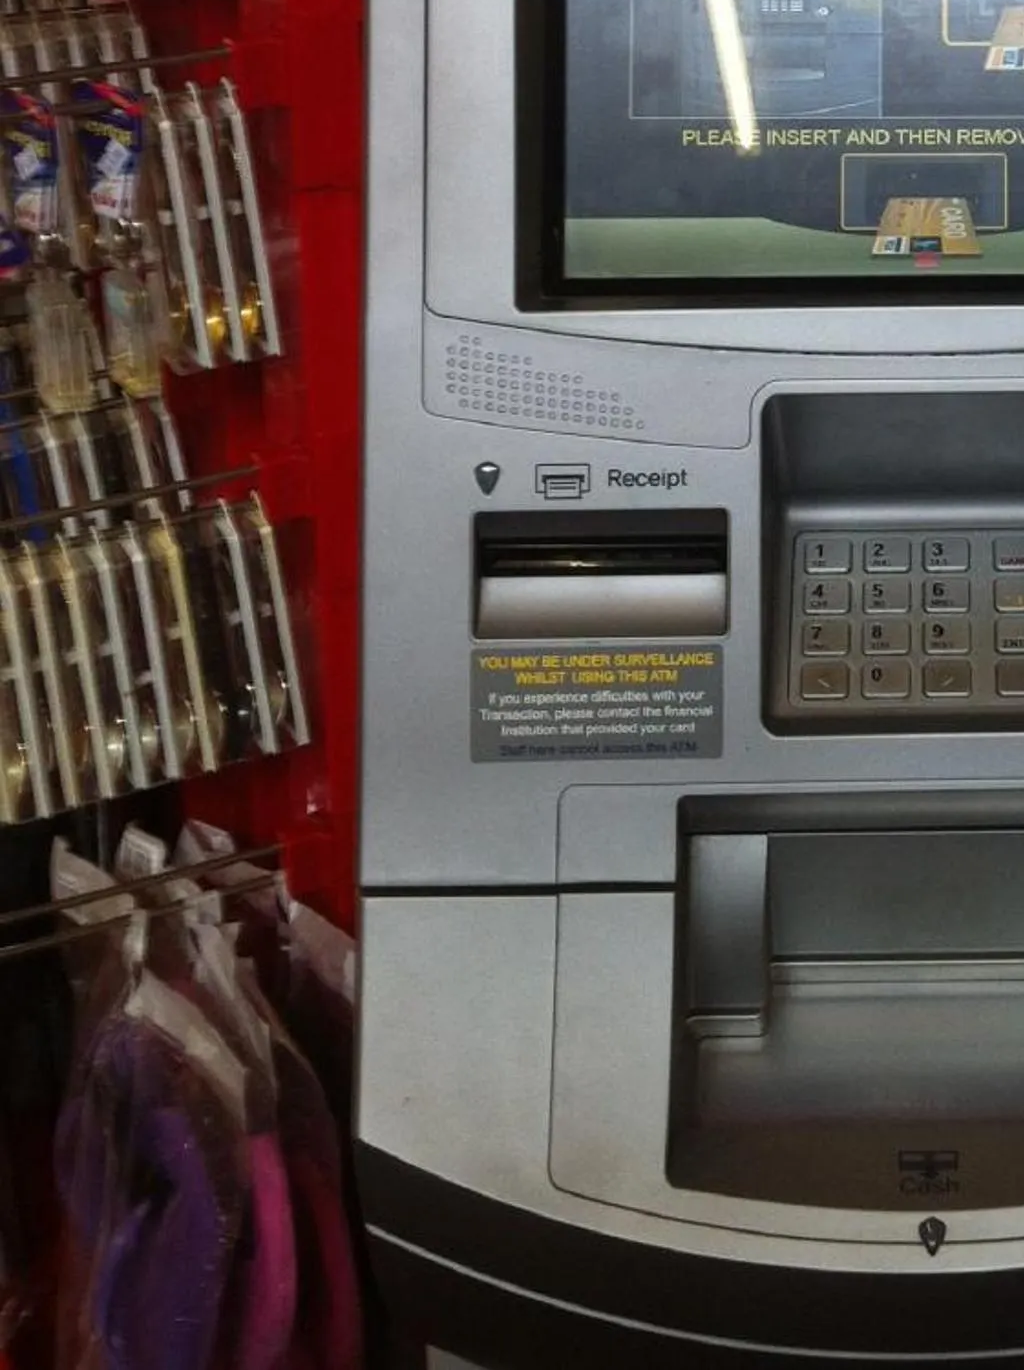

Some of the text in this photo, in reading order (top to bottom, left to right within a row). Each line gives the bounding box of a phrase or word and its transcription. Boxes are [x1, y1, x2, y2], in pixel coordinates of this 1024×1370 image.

[767, 129, 840, 145] INSERT
[846, 129, 890, 145] AND
[895, 128, 951, 145] THEN
[607, 468, 688, 490] Receipt
[815, 544, 824, 557] 1
[873, 543, 885, 557] 2
[932, 542, 944, 556] 3
[812, 584, 824, 598] 4
[872, 584, 884, 598] 5
[932, 582, 945, 597] 6
[811, 625, 822, 640] 7
[871, 624, 882, 639] 8
[931, 624, 944, 638] 9
[480, 652, 714, 670] YOU MAY BE UNDER SURVEILLANCE
[514, 669, 678, 685] WHILST USING THIS ATM
[871, 667, 882, 682] 0
[499, 694, 520, 708] you
[523, 693, 588, 706] experience
[590, 690, 649, 703] difficulties
[652, 690, 676, 702] with
[679, 691, 706, 704] your
[554, 708, 594, 721] please
[597, 707, 640, 719] contact
[642, 706, 662, 717] the
[664, 705, 713, 718] financial
[561, 724, 584, 735] that
[586, 723, 638, 738] provided
[640, 724, 667, 737] your
[669, 722, 696, 734] card
